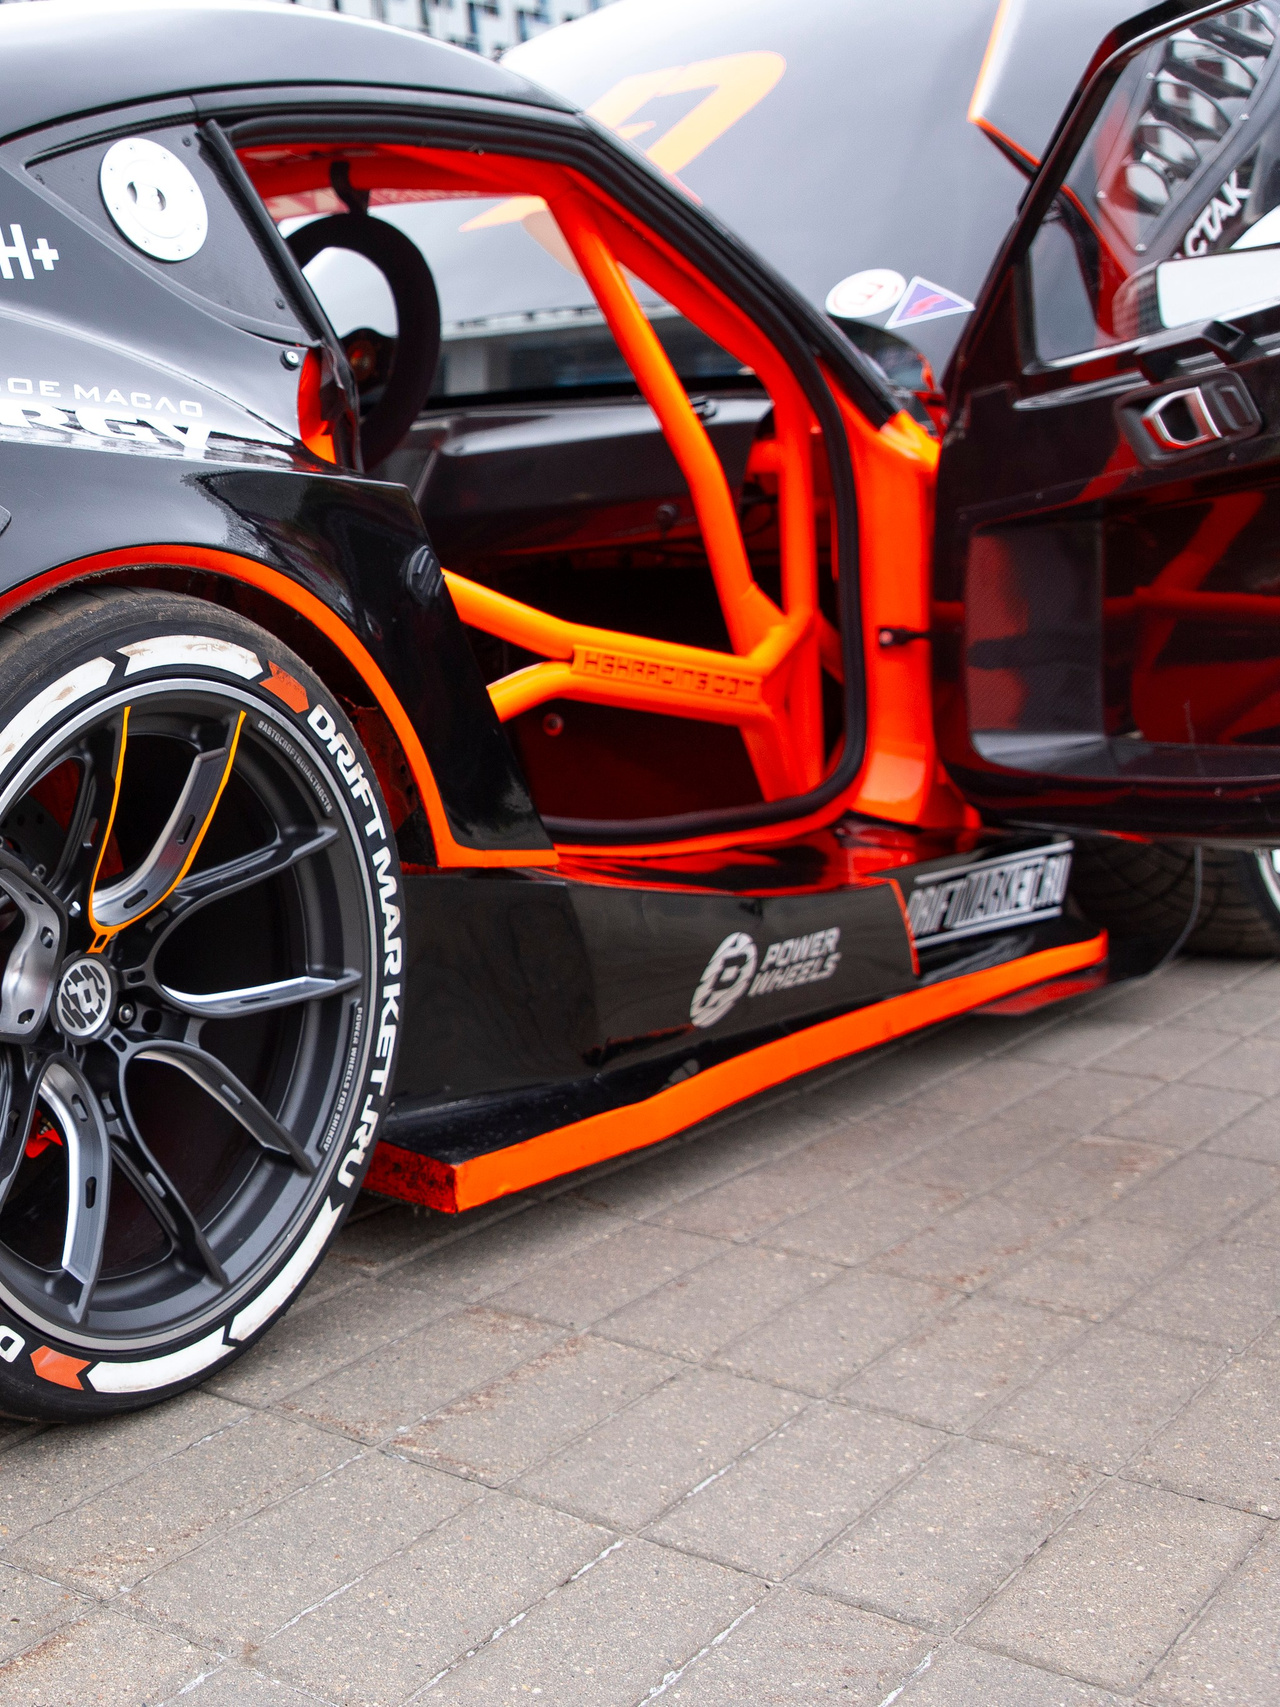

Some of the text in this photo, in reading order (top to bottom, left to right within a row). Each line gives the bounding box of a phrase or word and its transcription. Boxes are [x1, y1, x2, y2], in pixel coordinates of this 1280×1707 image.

[760, 927, 841, 971] POWER
[748, 952, 842, 998] WHEELS
[323, 1007, 363, 1151] POWER WHEELS FOR SHIKOV
